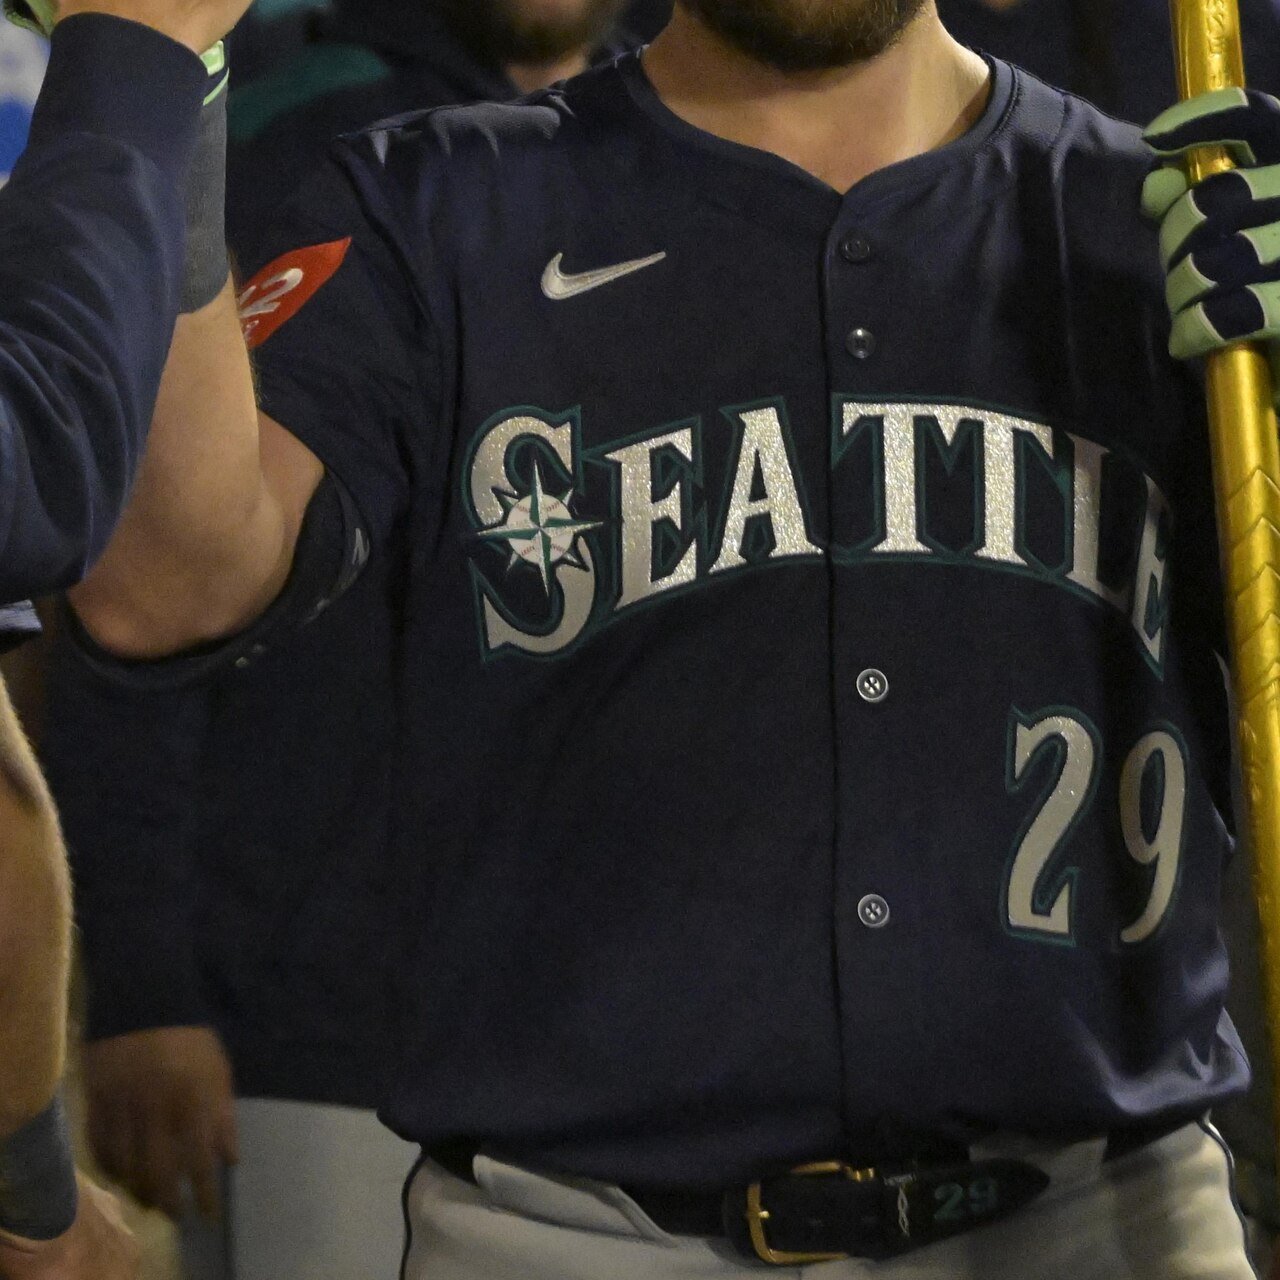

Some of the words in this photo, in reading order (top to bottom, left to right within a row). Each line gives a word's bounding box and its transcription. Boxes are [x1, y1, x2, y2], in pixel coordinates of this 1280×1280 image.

[462, 388, 1173, 680] SEATTLE
[1001, 704, 1187, 946] 29
[933, 1176, 998, 1221] 29
